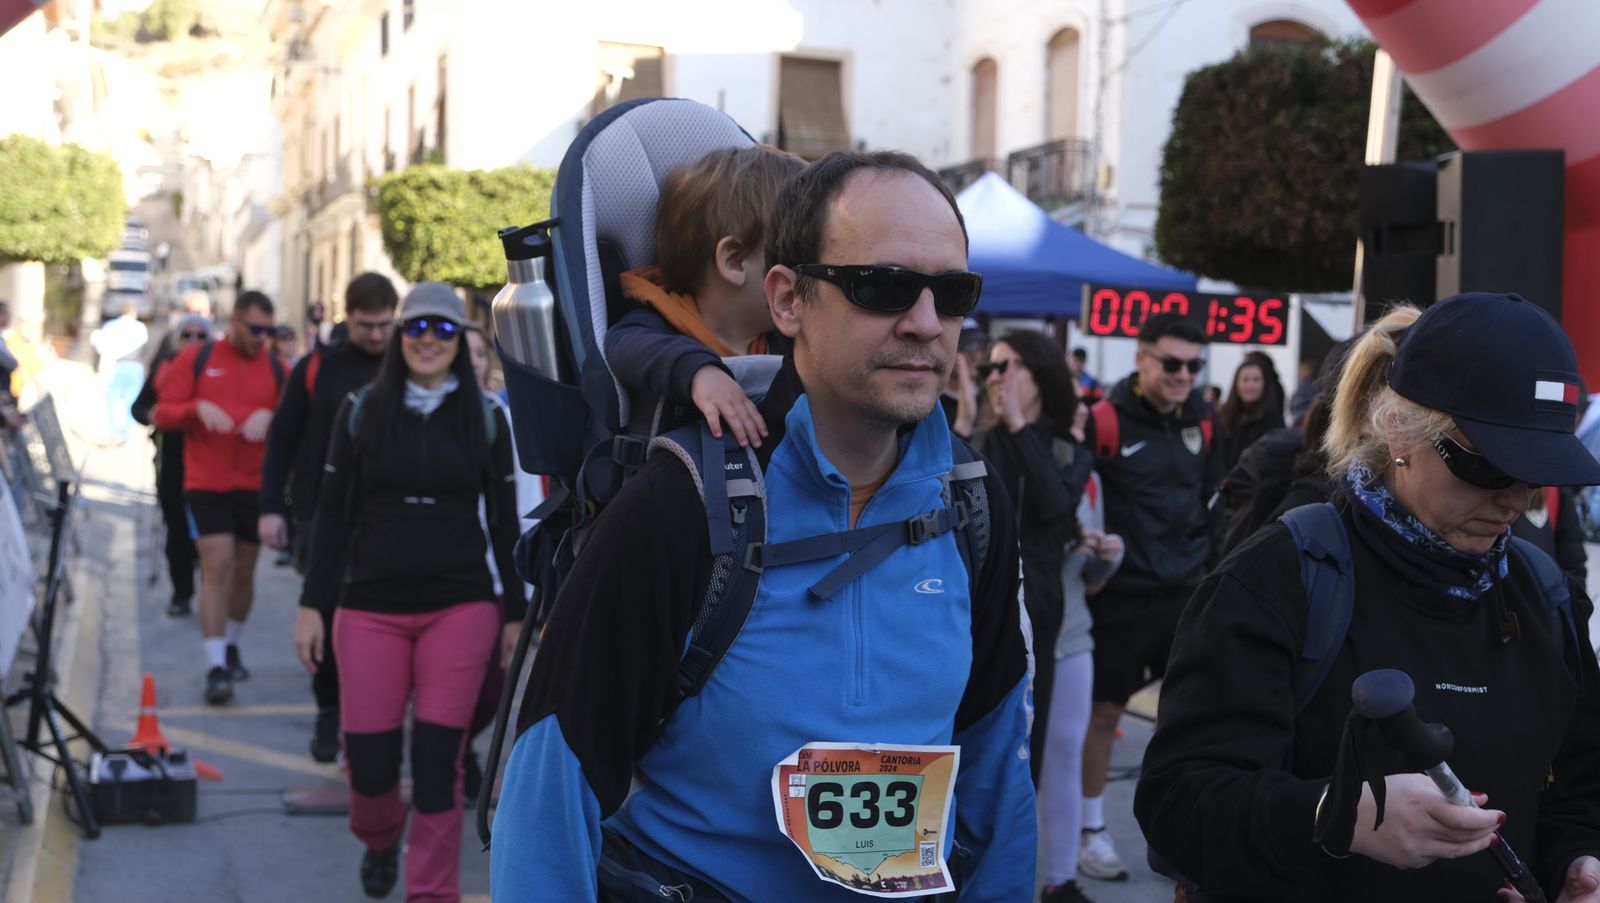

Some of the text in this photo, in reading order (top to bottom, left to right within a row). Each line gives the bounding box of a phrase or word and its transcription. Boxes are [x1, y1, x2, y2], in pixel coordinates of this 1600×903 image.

[725, 462, 743, 470] uter
[797, 757, 861, 773] LA PÓLVORA
[881, 755, 921, 765] CANTORIA
[880, 764, 897, 773] 2024
[807, 781, 918, 829] 633
[855, 839, 874, 849] LUIS
